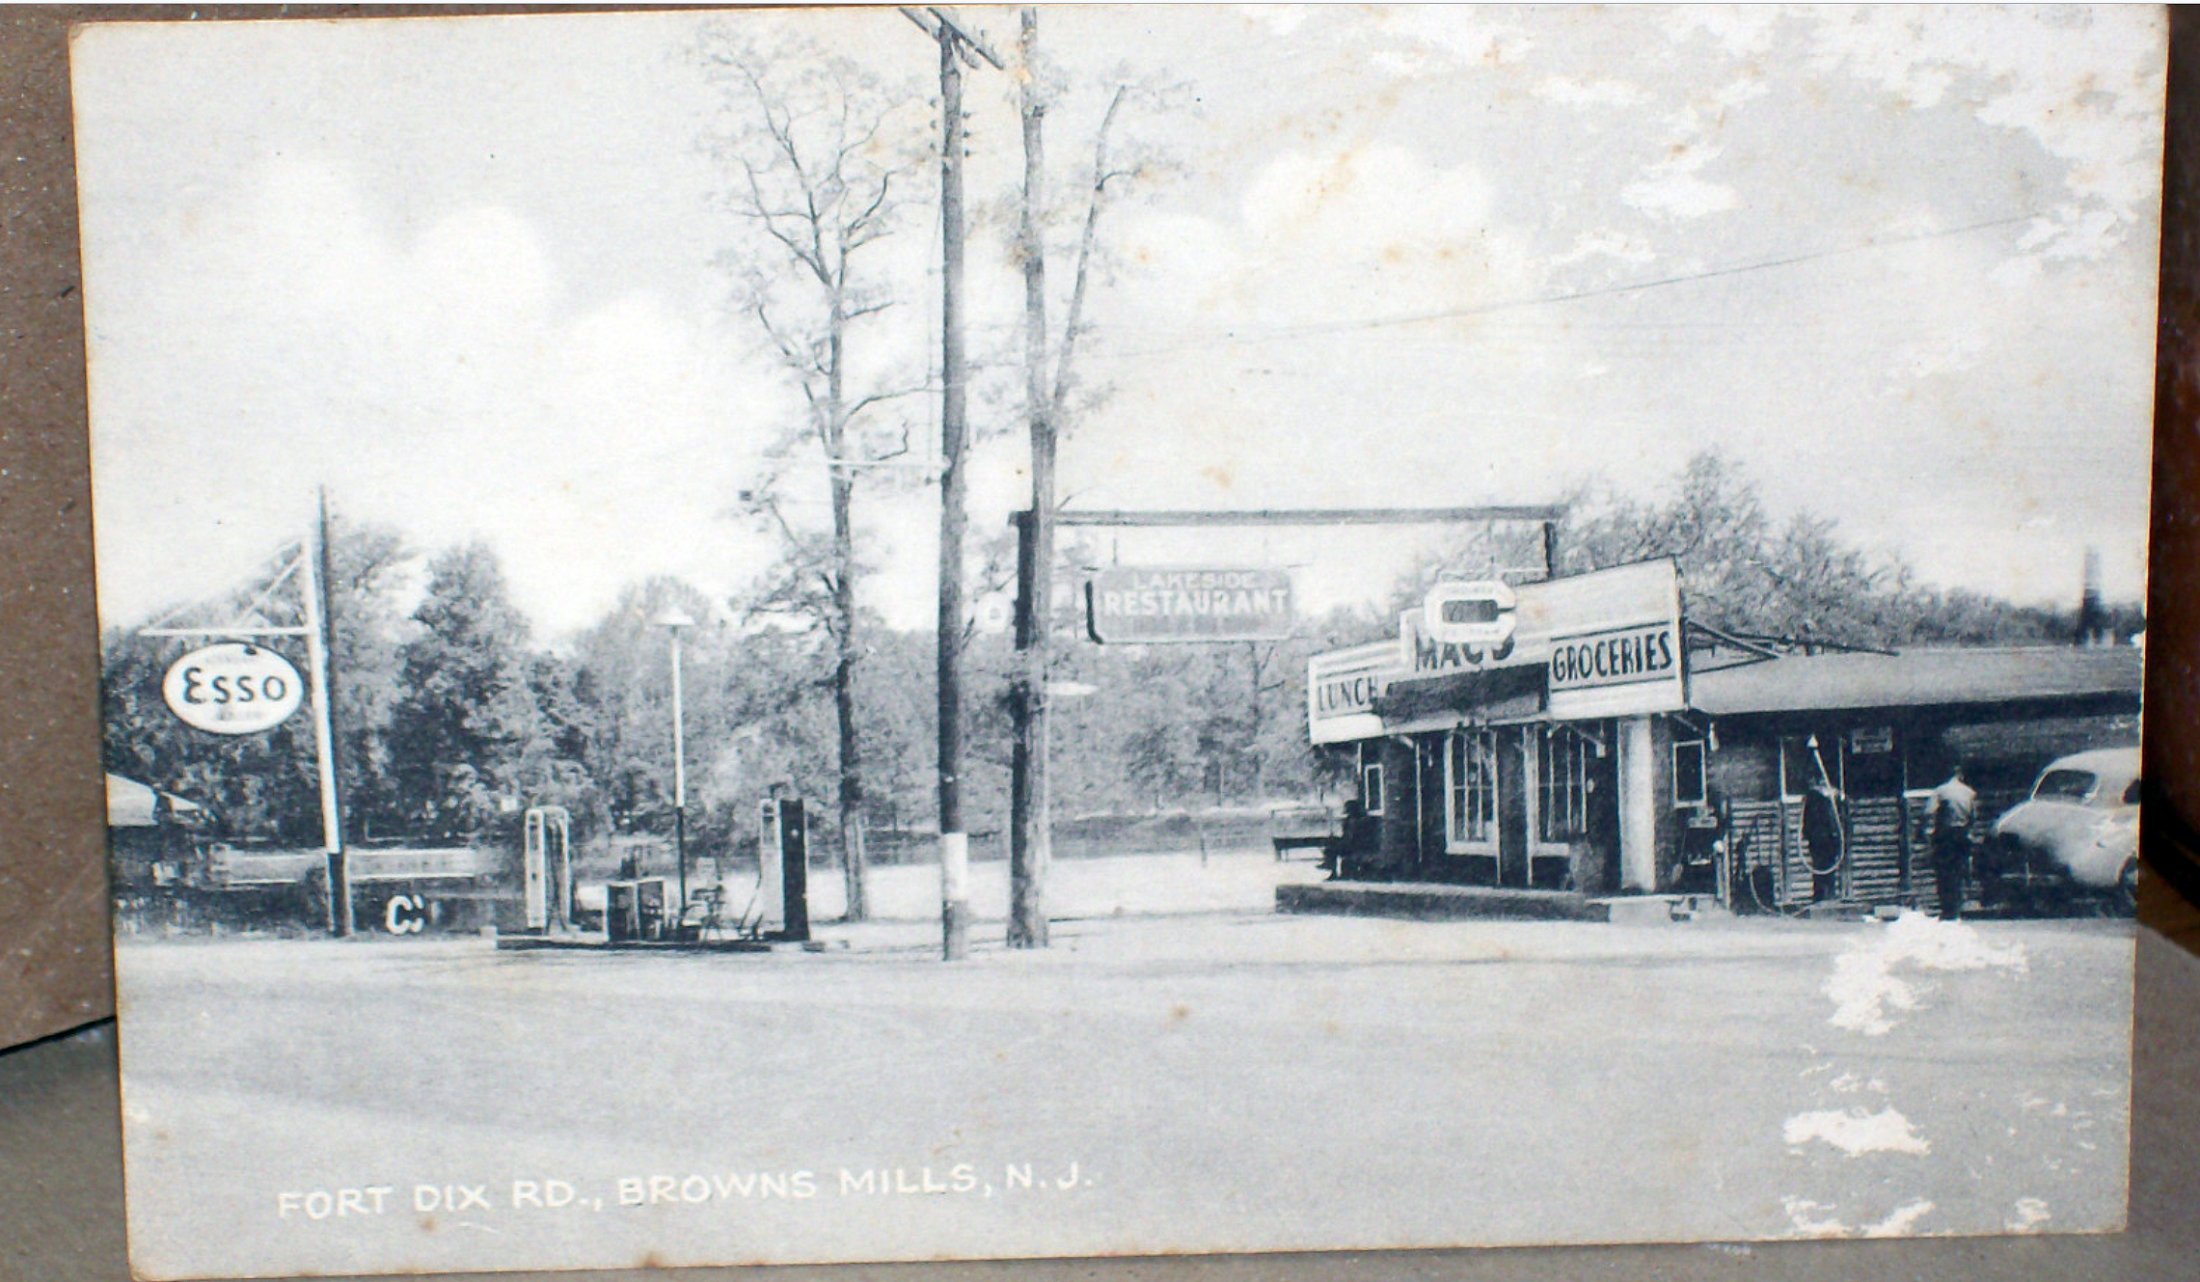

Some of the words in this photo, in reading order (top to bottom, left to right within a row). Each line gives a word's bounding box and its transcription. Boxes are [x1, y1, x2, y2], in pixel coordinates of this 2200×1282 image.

[1133, 571, 1257, 590] LAKESIDE
[1103, 589, 1289, 616] RESTAURANT
[1552, 630, 1673, 682] GROCERIES
[1316, 675, 1379, 712] LUNCH
